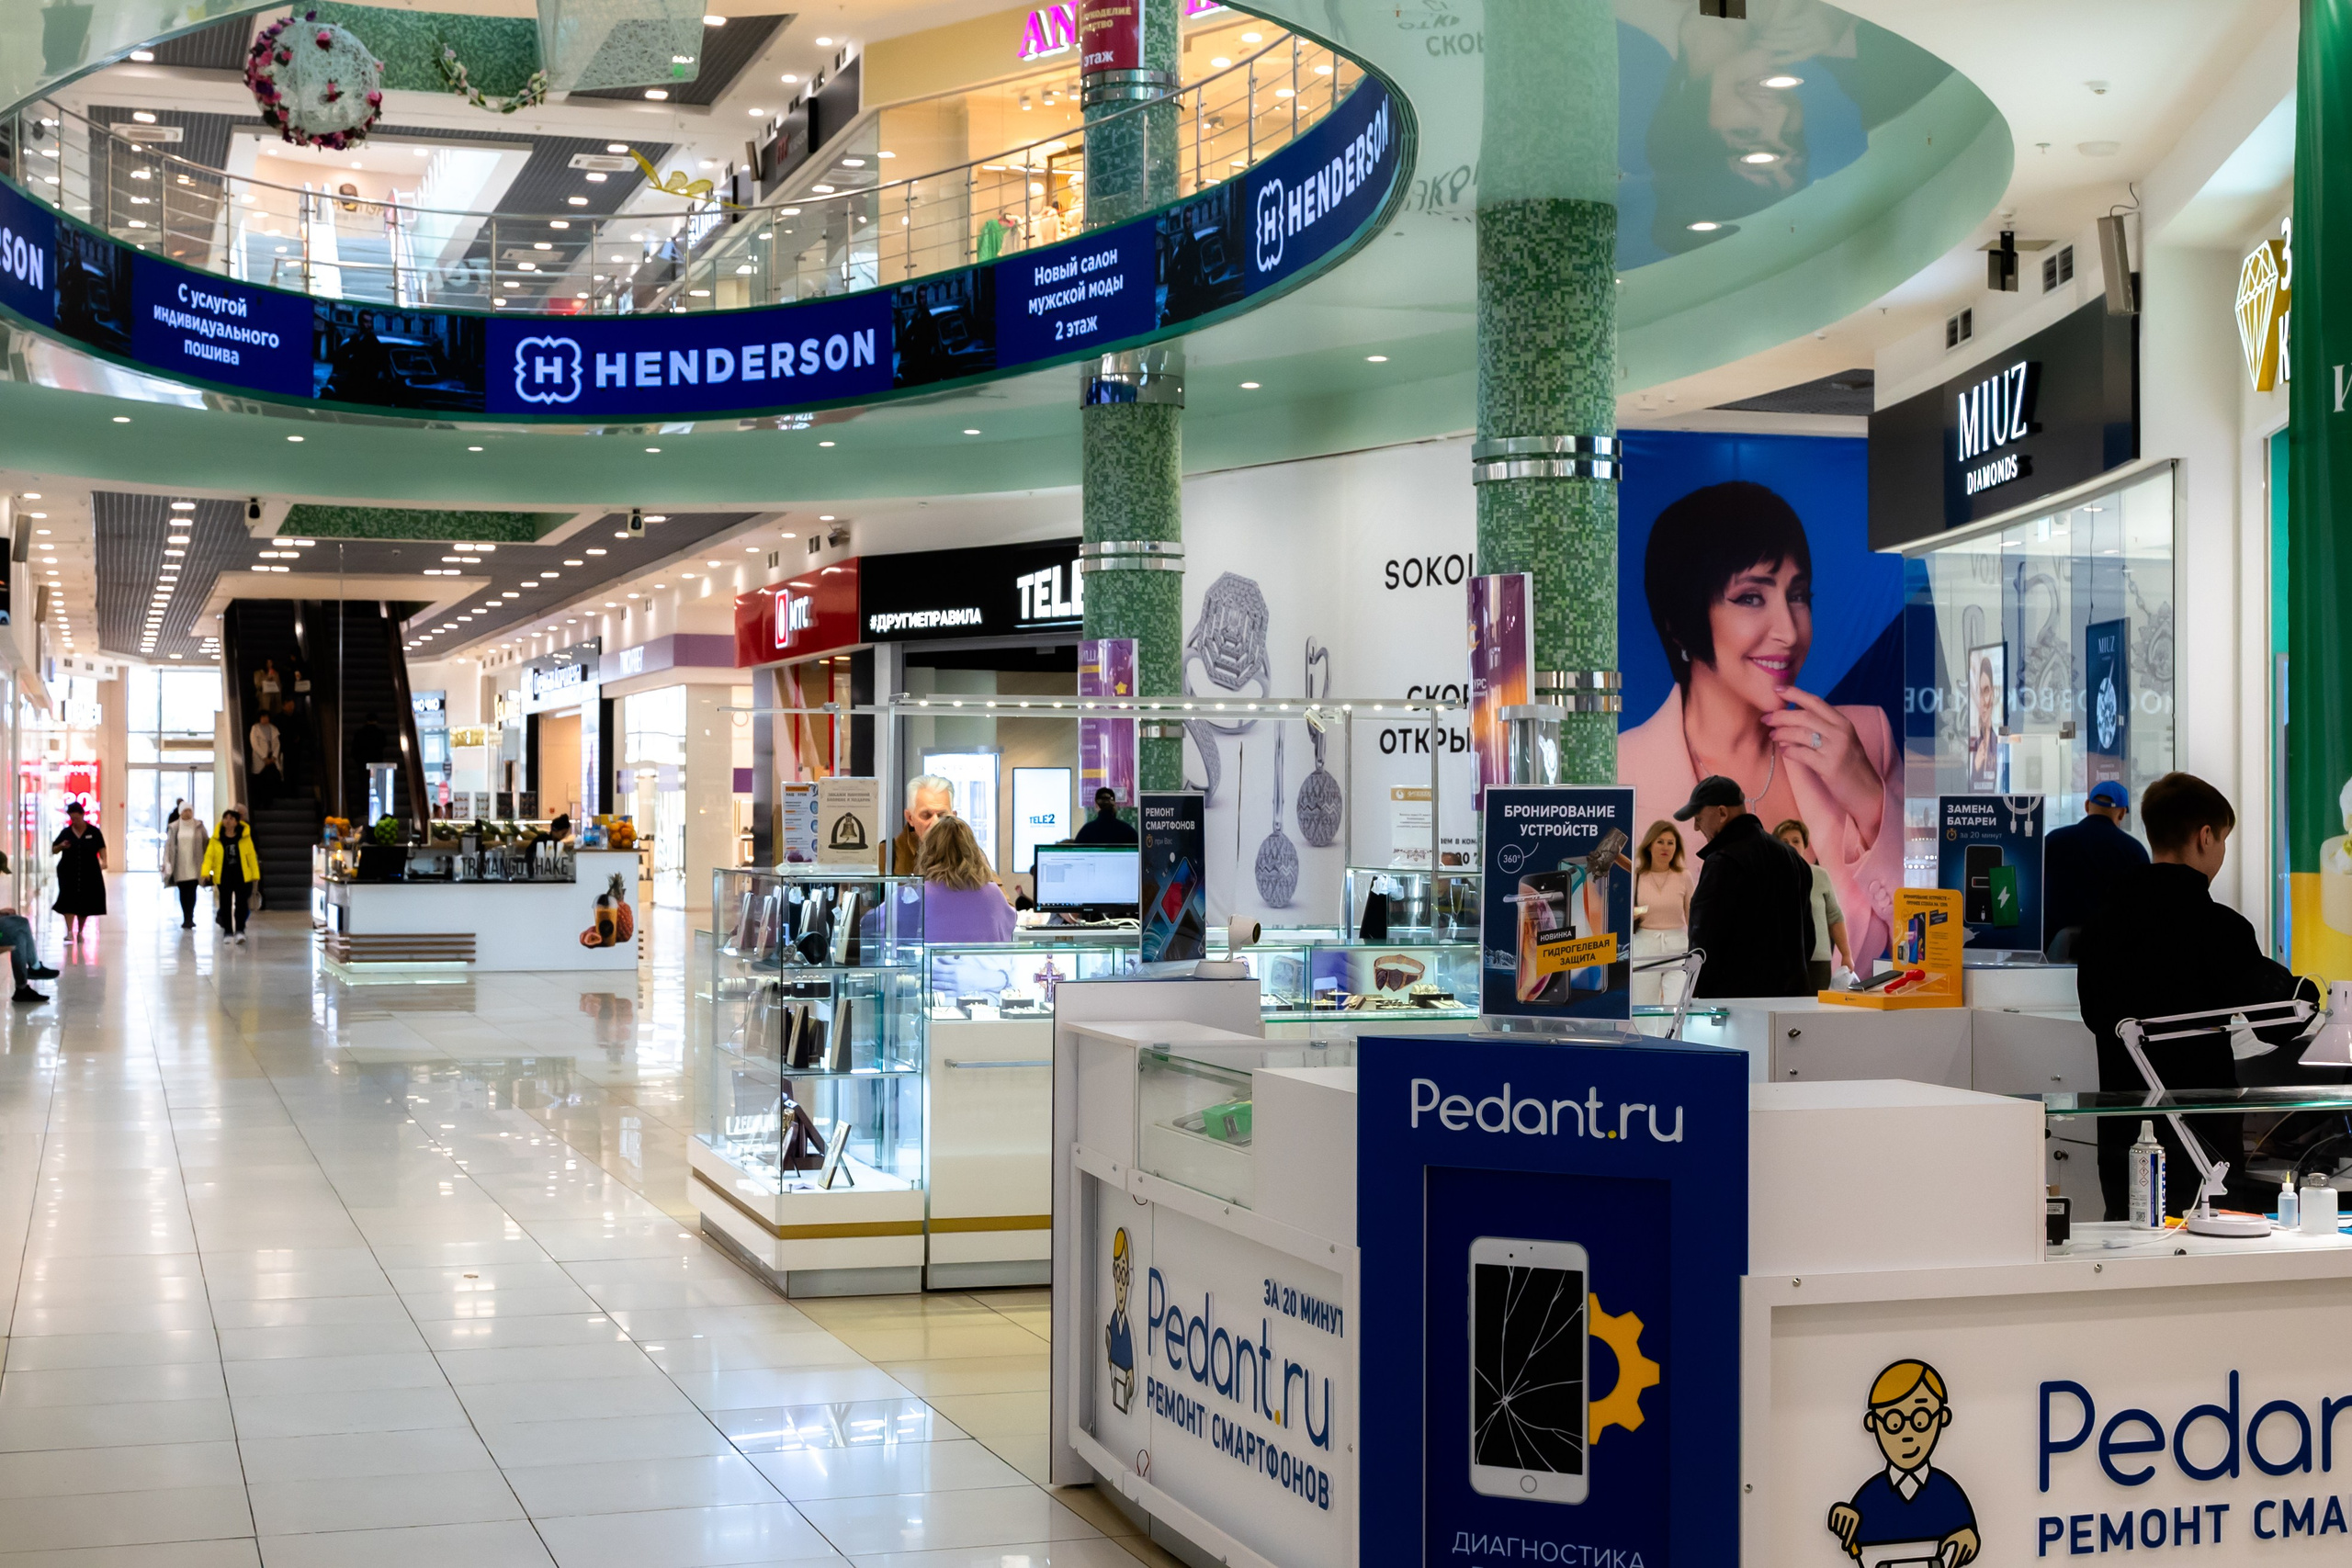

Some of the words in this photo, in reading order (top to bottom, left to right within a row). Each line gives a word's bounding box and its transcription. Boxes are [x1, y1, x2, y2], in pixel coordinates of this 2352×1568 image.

[1288, 94, 1389, 237] HENDERSON
[0, 226, 44, 291] SON
[1035, 255, 1078, 287] Новый
[1080, 248, 1118, 274] салон
[177, 283, 188, 302] С
[191, 289, 248, 318] услугой
[1028, 280, 1085, 316] мужской
[1089, 274, 1124, 298] моды
[153, 304, 280, 349] индивидуального
[1055, 321, 1064, 341] 2
[1066, 315, 1098, 338] этаж
[184, 339, 240, 366] пошива
[595, 328, 876, 389] HENDERSON
[1959, 361, 2028, 461] MIUZ
[1966, 454, 2018, 495] DIAMONDS
[788, 595, 810, 631] МТС
[869, 607, 983, 633] #ДРУГИЕПРАВИЛА
[1029, 814, 1056, 825] TELE2
[1145, 807, 1174, 818] РЕМОНТ
[1145, 820, 1195, 830] СМАРТФОНОВ
[1504, 805, 1615, 818] БРОНИРОВАНИЕ
[1947, 805, 1995, 814] ЗАМЕНА
[1947, 817, 1996, 826] БАТАРЕИ
[1520, 821, 1599, 837] УСТРОЙСТВ
[536, 856, 569, 875] HAKE
[1503, 854, 1521, 863] 360°
[1540, 930, 1572, 942] НОВИНКА
[1543, 939, 1610, 957] ГИДРОГЕЛЕВАЯ
[1560, 953, 1596, 965] ЗАЩИТА
[1411, 1077, 1683, 1143] Pedant.ru
[1263, 1279, 1280, 1311] ЗА
[1283, 1287, 1297, 1318] 20
[1300, 1293, 1344, 1338] МИНУТ
[1148, 1266, 1329, 1451] Pedant.ru
[1147, 1375, 1205, 1439] РЕМОНТ
[1212, 1413, 1329, 1511] СМАРТФОНОВ
[2037, 1503, 2231, 1557] РЕМОНТ
[2253, 1495, 2352, 1540] СМА
[1452, 1531, 1645, 1568] ДИАГНОСТИКА
